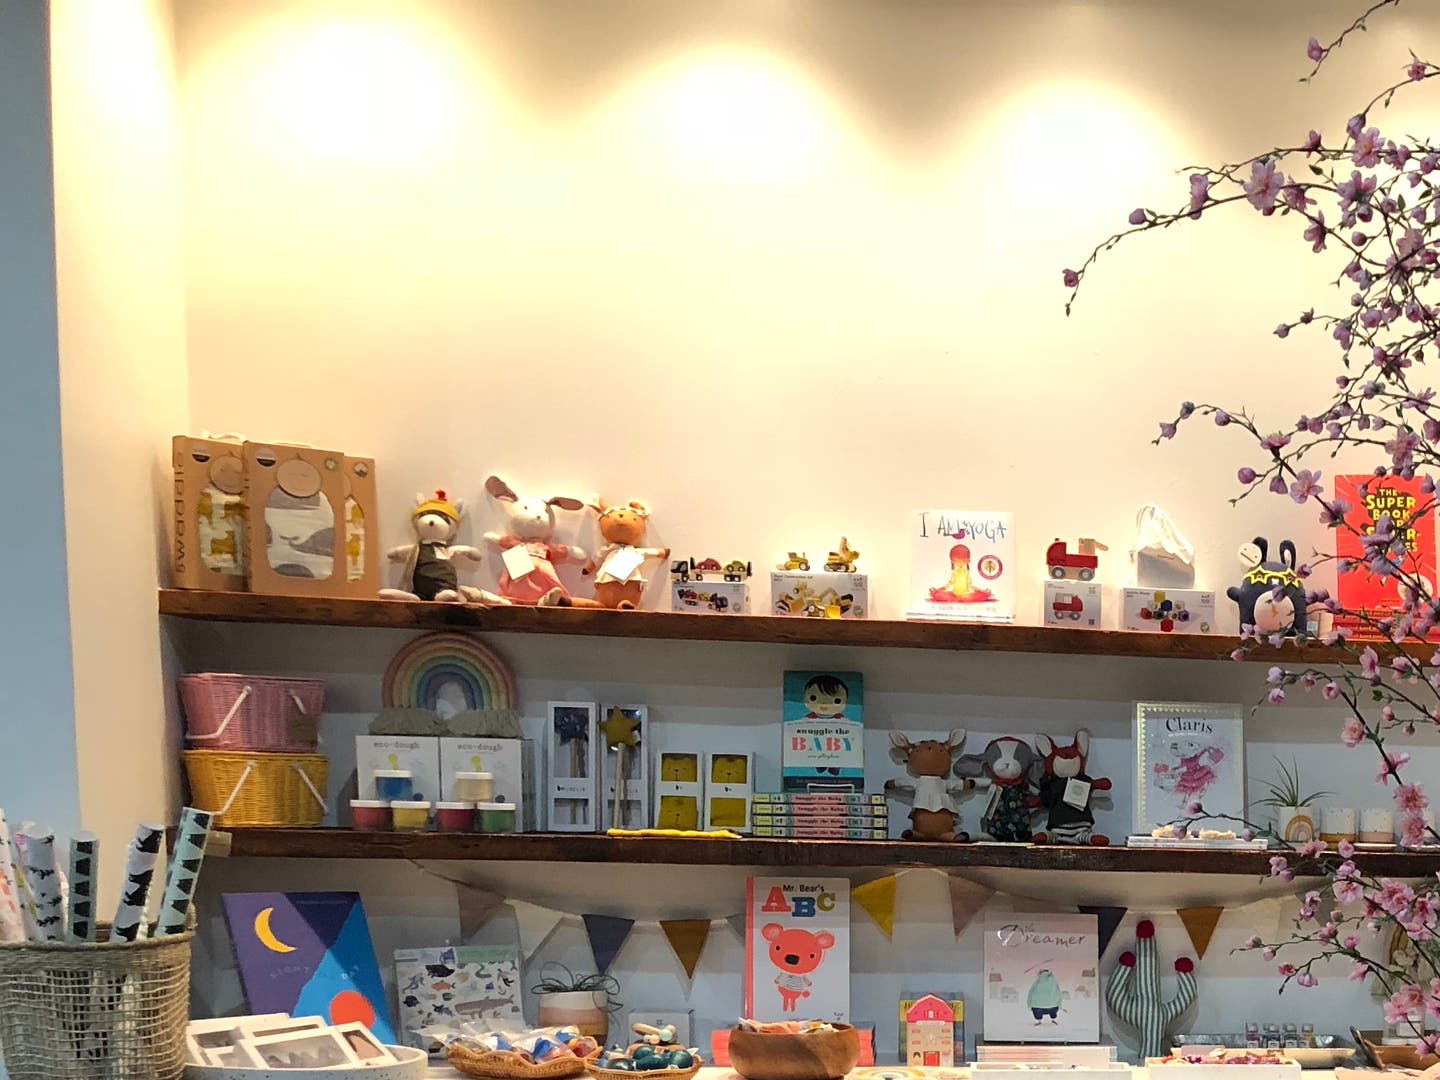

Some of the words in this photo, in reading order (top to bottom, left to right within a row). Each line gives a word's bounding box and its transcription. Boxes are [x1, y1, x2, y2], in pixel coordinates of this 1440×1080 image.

[1379, 488, 1398, 497] THE
[1366, 495, 1416, 510] SUPER
[1373, 509, 1411, 521] BOOK
[918, 512, 929, 538] I
[937, 515, 961, 537] AM
[969, 520, 1007, 543] YOGA
[796, 727, 833, 736] snuggle
[1165, 716, 1213, 735] Claris
[792, 737, 853, 752] BABY
[782, 884, 797, 893] Mr.
[799, 884, 825, 893] Bear's
[761, 886, 836, 918] ABC
[997, 924, 1085, 948] Dreamer
